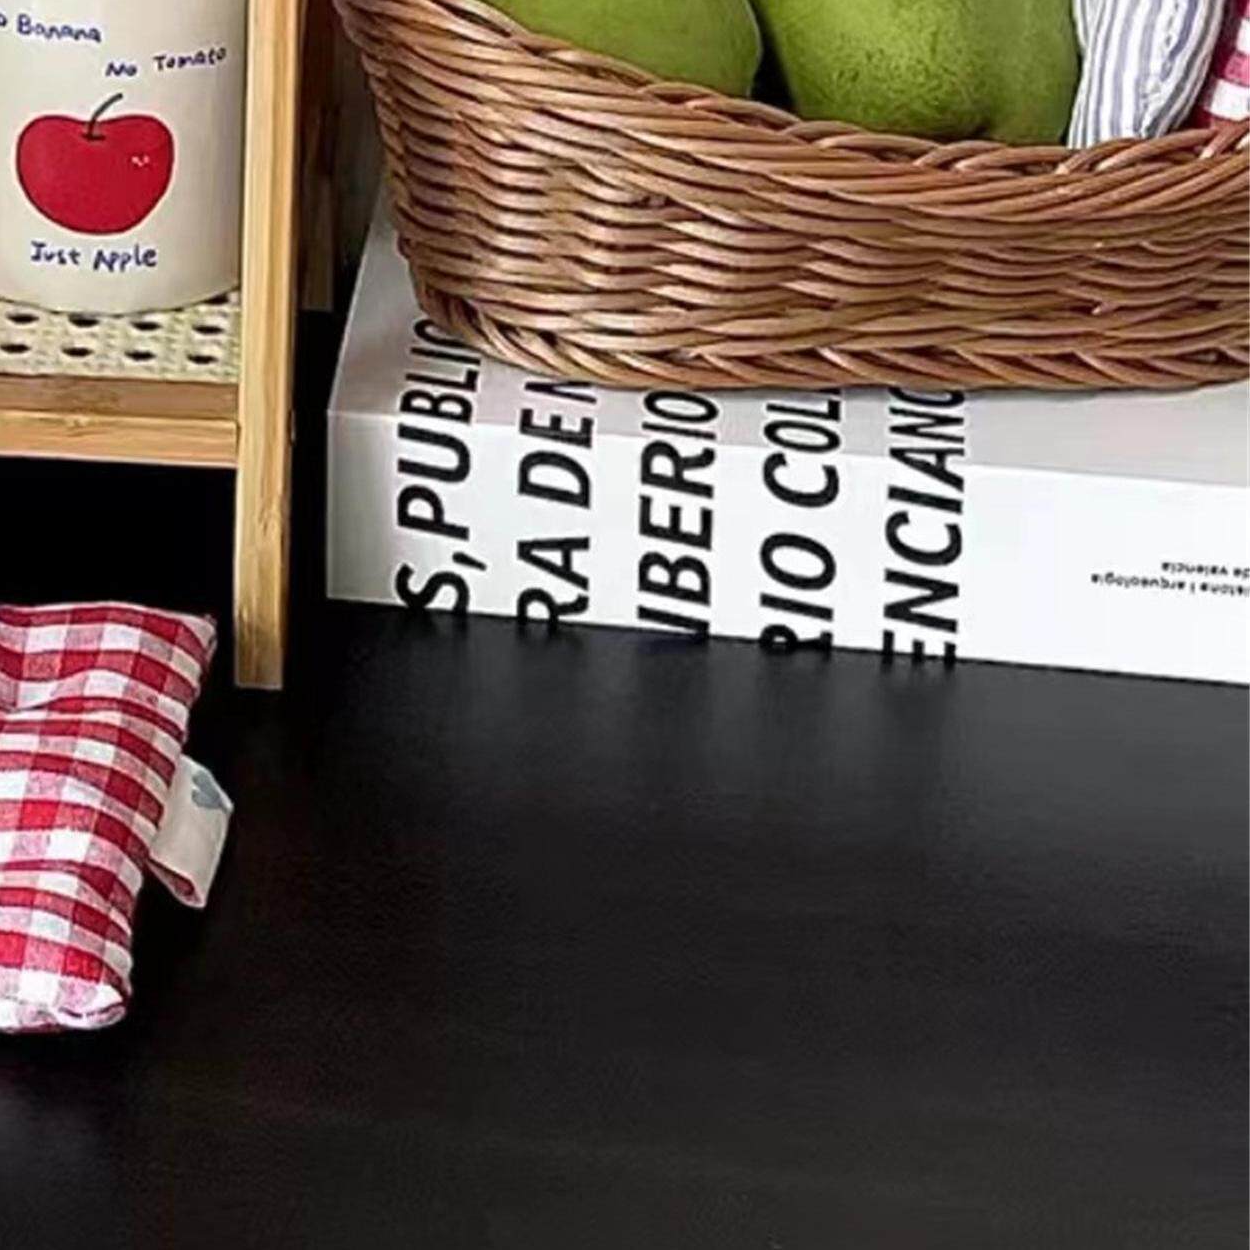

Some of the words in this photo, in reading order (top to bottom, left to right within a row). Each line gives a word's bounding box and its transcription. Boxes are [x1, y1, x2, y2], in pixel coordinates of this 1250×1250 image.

[17, 14, 101, 43] Banana
[105, 61, 138, 77] No
[153, 47, 226, 71] Tomato
[31, 240, 81, 266] Just
[93, 243, 158, 272] Apple
